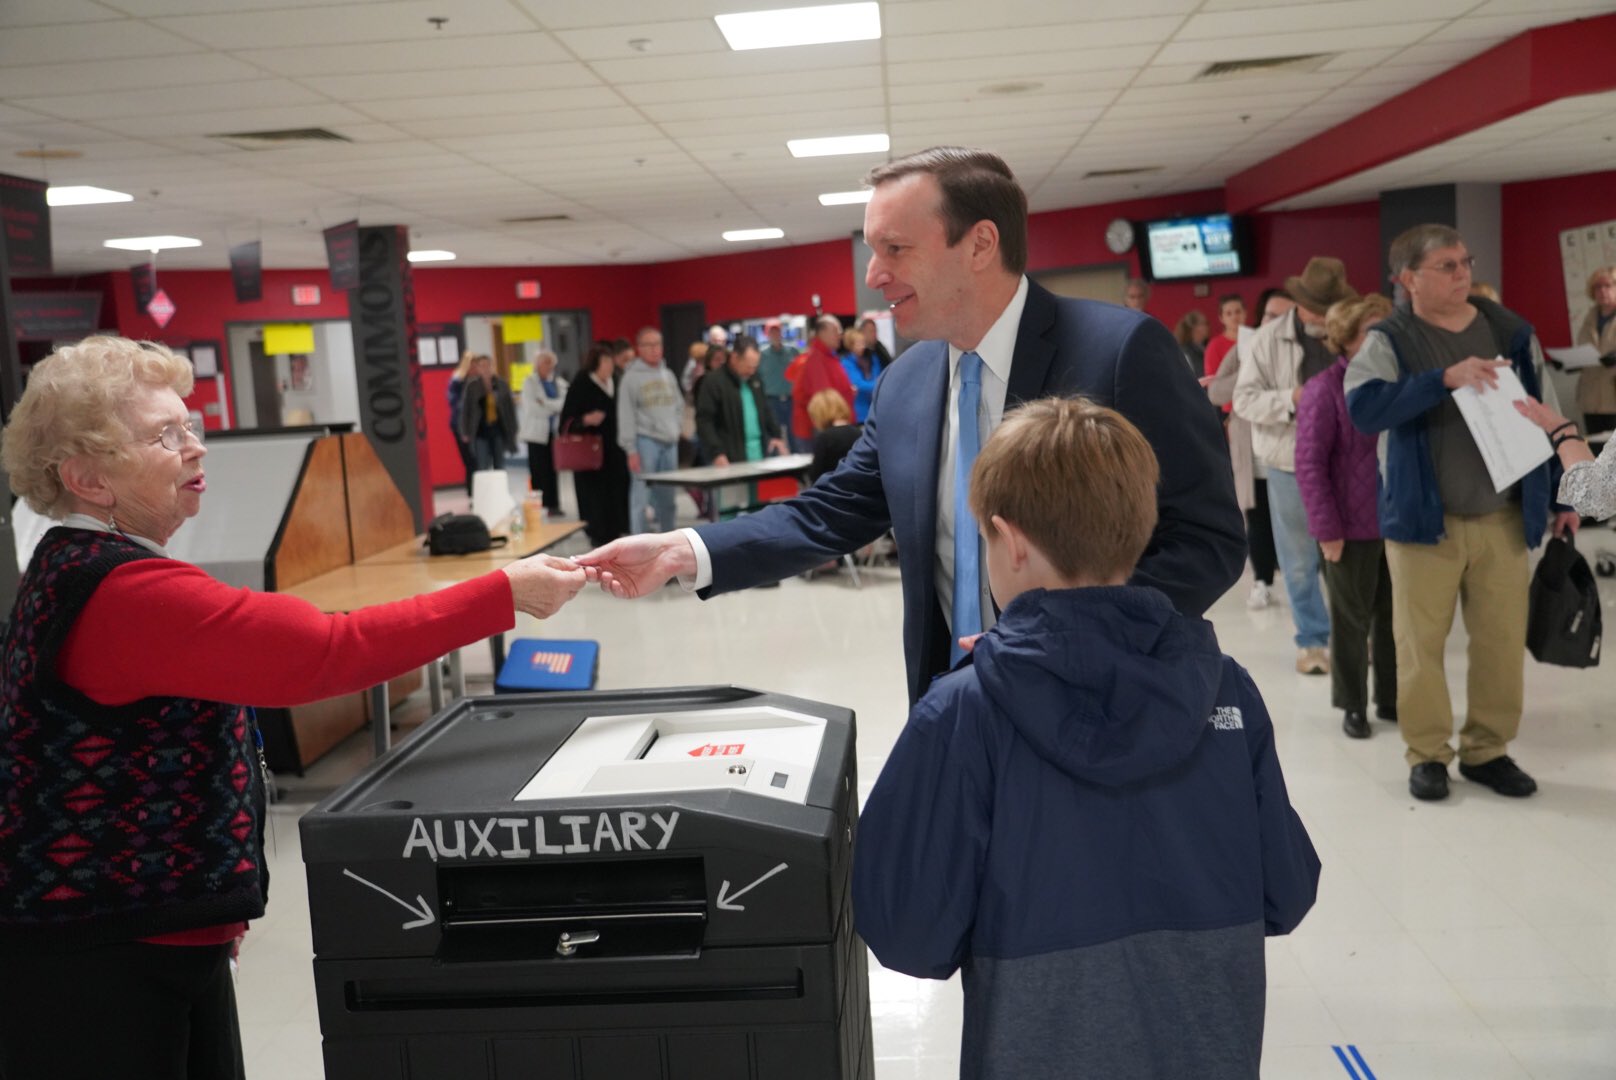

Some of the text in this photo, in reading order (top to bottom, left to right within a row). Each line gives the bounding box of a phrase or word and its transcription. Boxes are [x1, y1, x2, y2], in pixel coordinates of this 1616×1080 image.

[359, 229, 407, 444] COMMONS
[1214, 721, 1236, 730] FACE
[1215, 706, 1232, 716] THE
[402, 811, 680, 862] AUXILIARY
